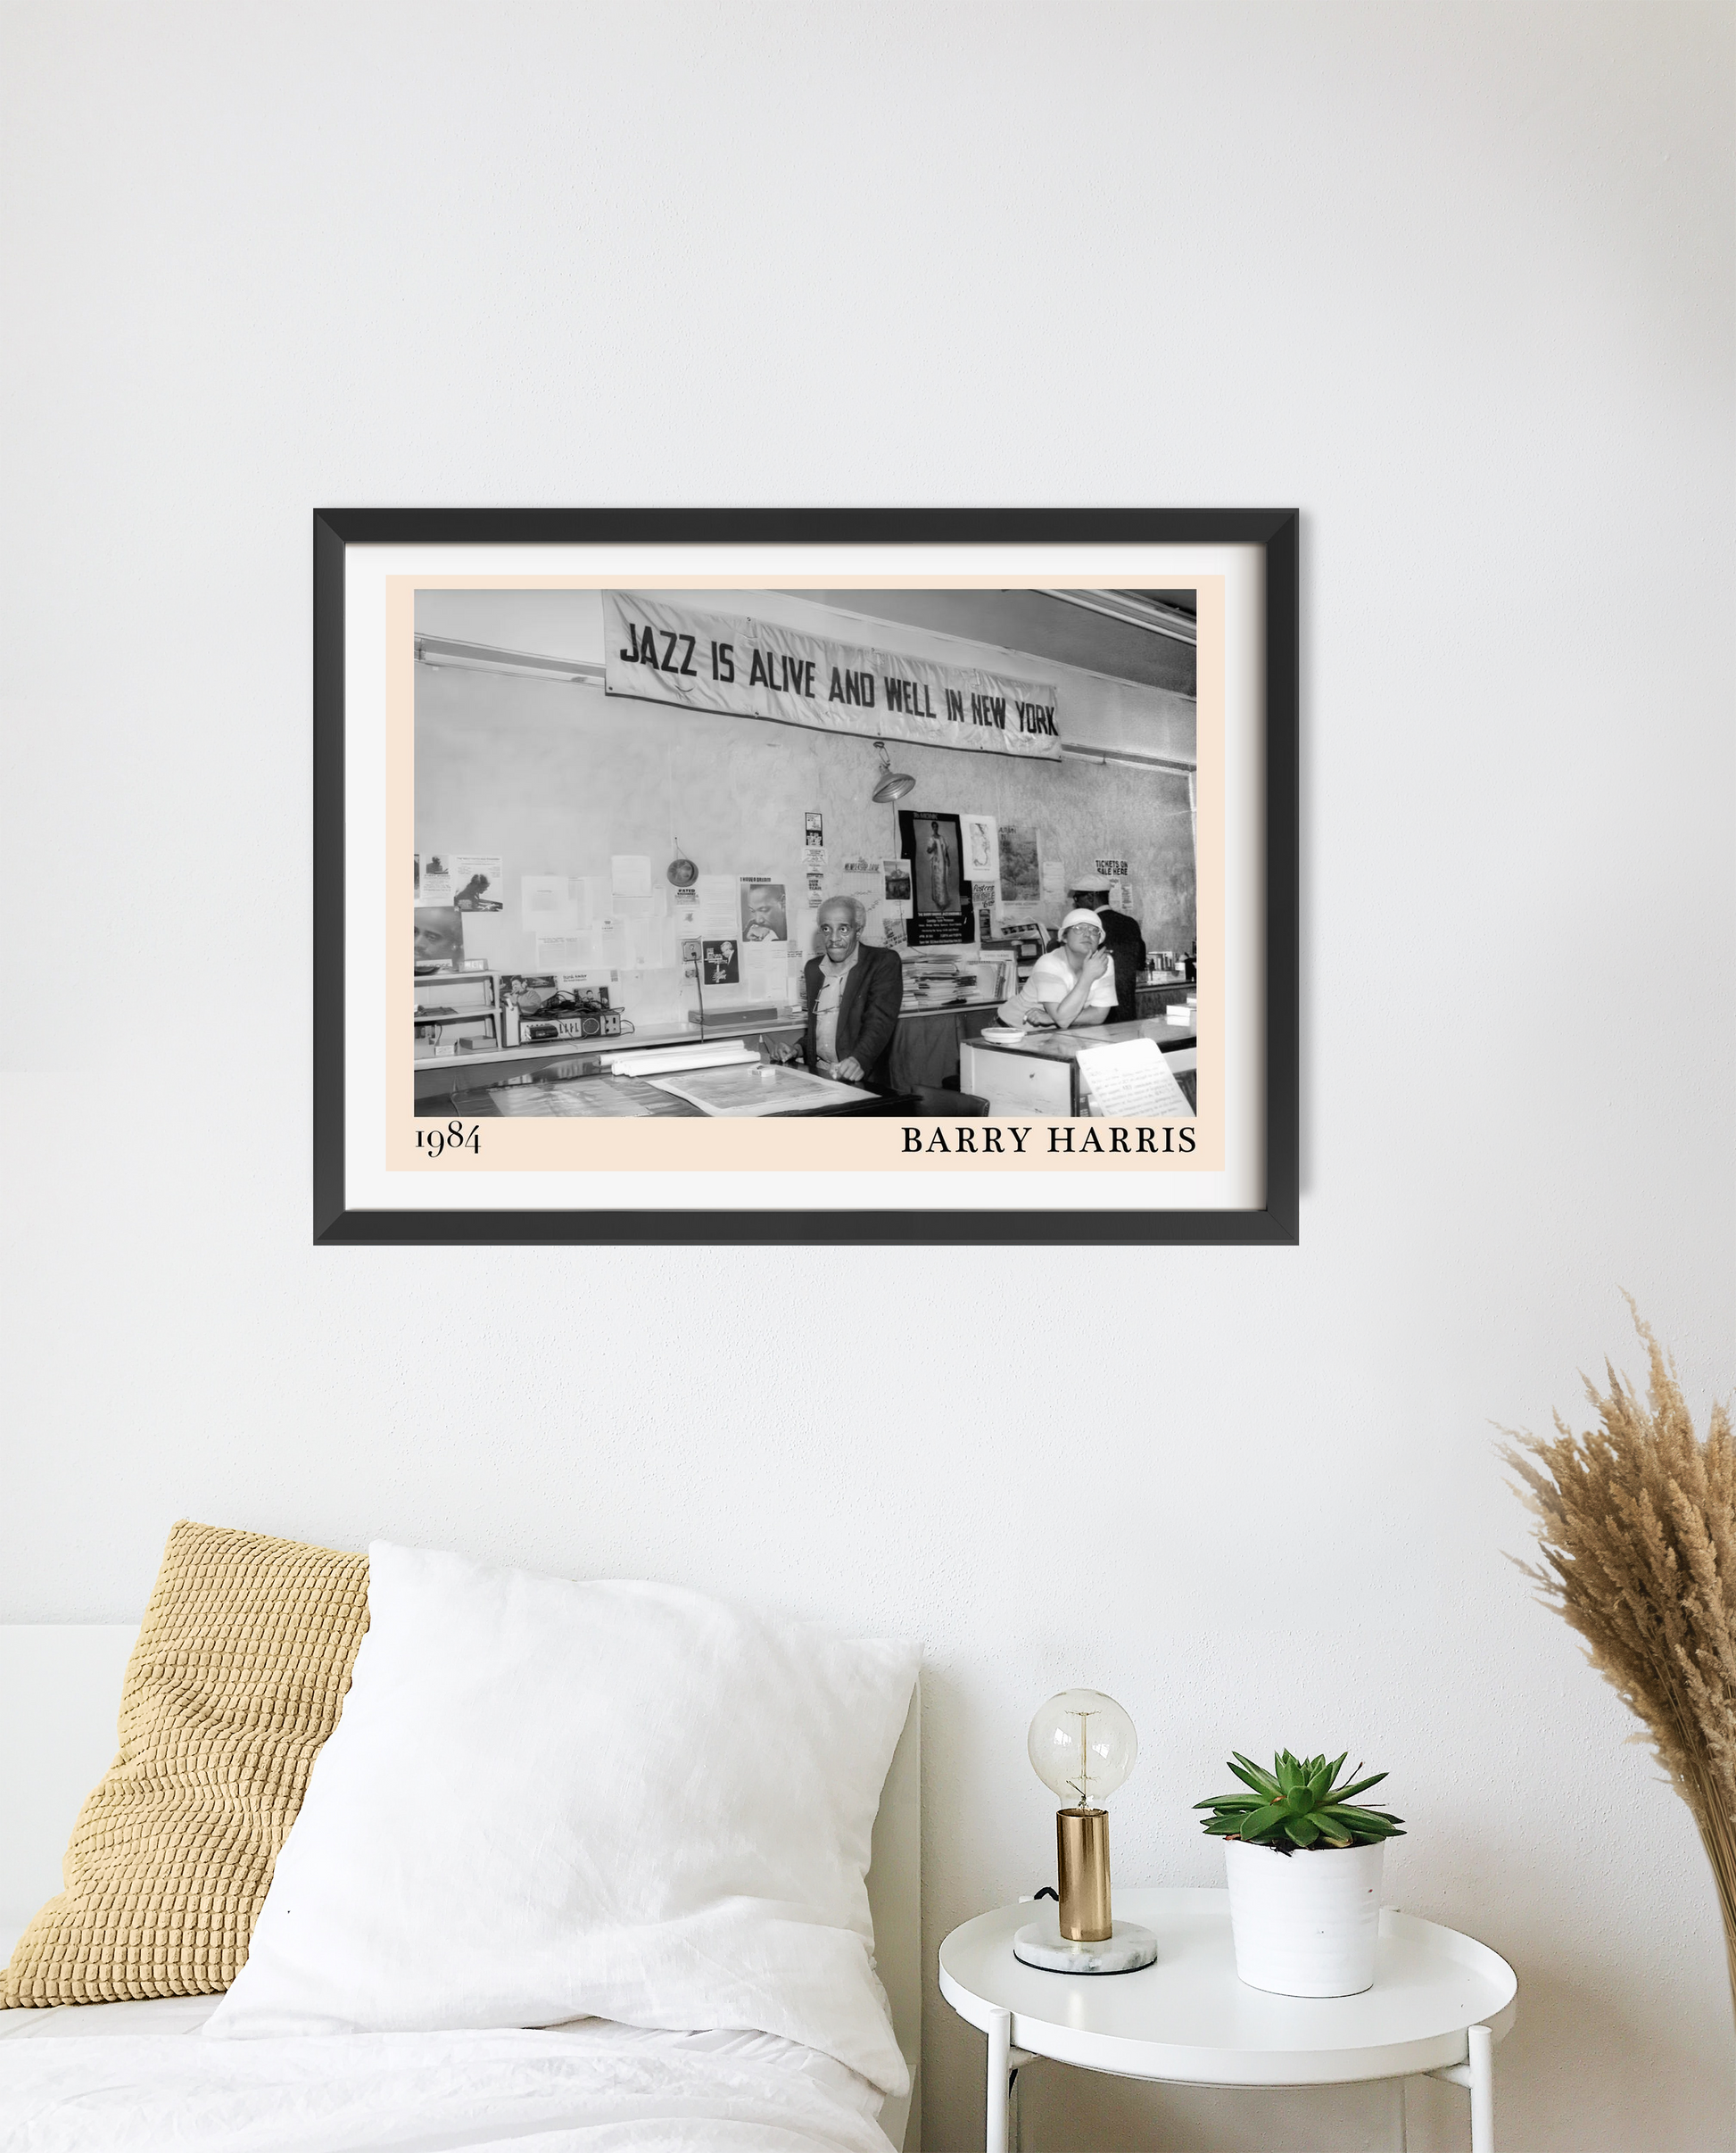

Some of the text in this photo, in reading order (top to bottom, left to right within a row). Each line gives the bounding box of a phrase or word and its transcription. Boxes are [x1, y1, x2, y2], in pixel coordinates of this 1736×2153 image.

[620, 623, 1060, 737] JAZZ IS ALIVE AND WELL IN NEW YORK
[1095, 859, 1128, 868] TICKETS ON
[1112, 867, 1128, 875] HERE
[416, 1121, 481, 1157] 1984
[901, 1127, 1196, 1153] BARRY HARRIS
